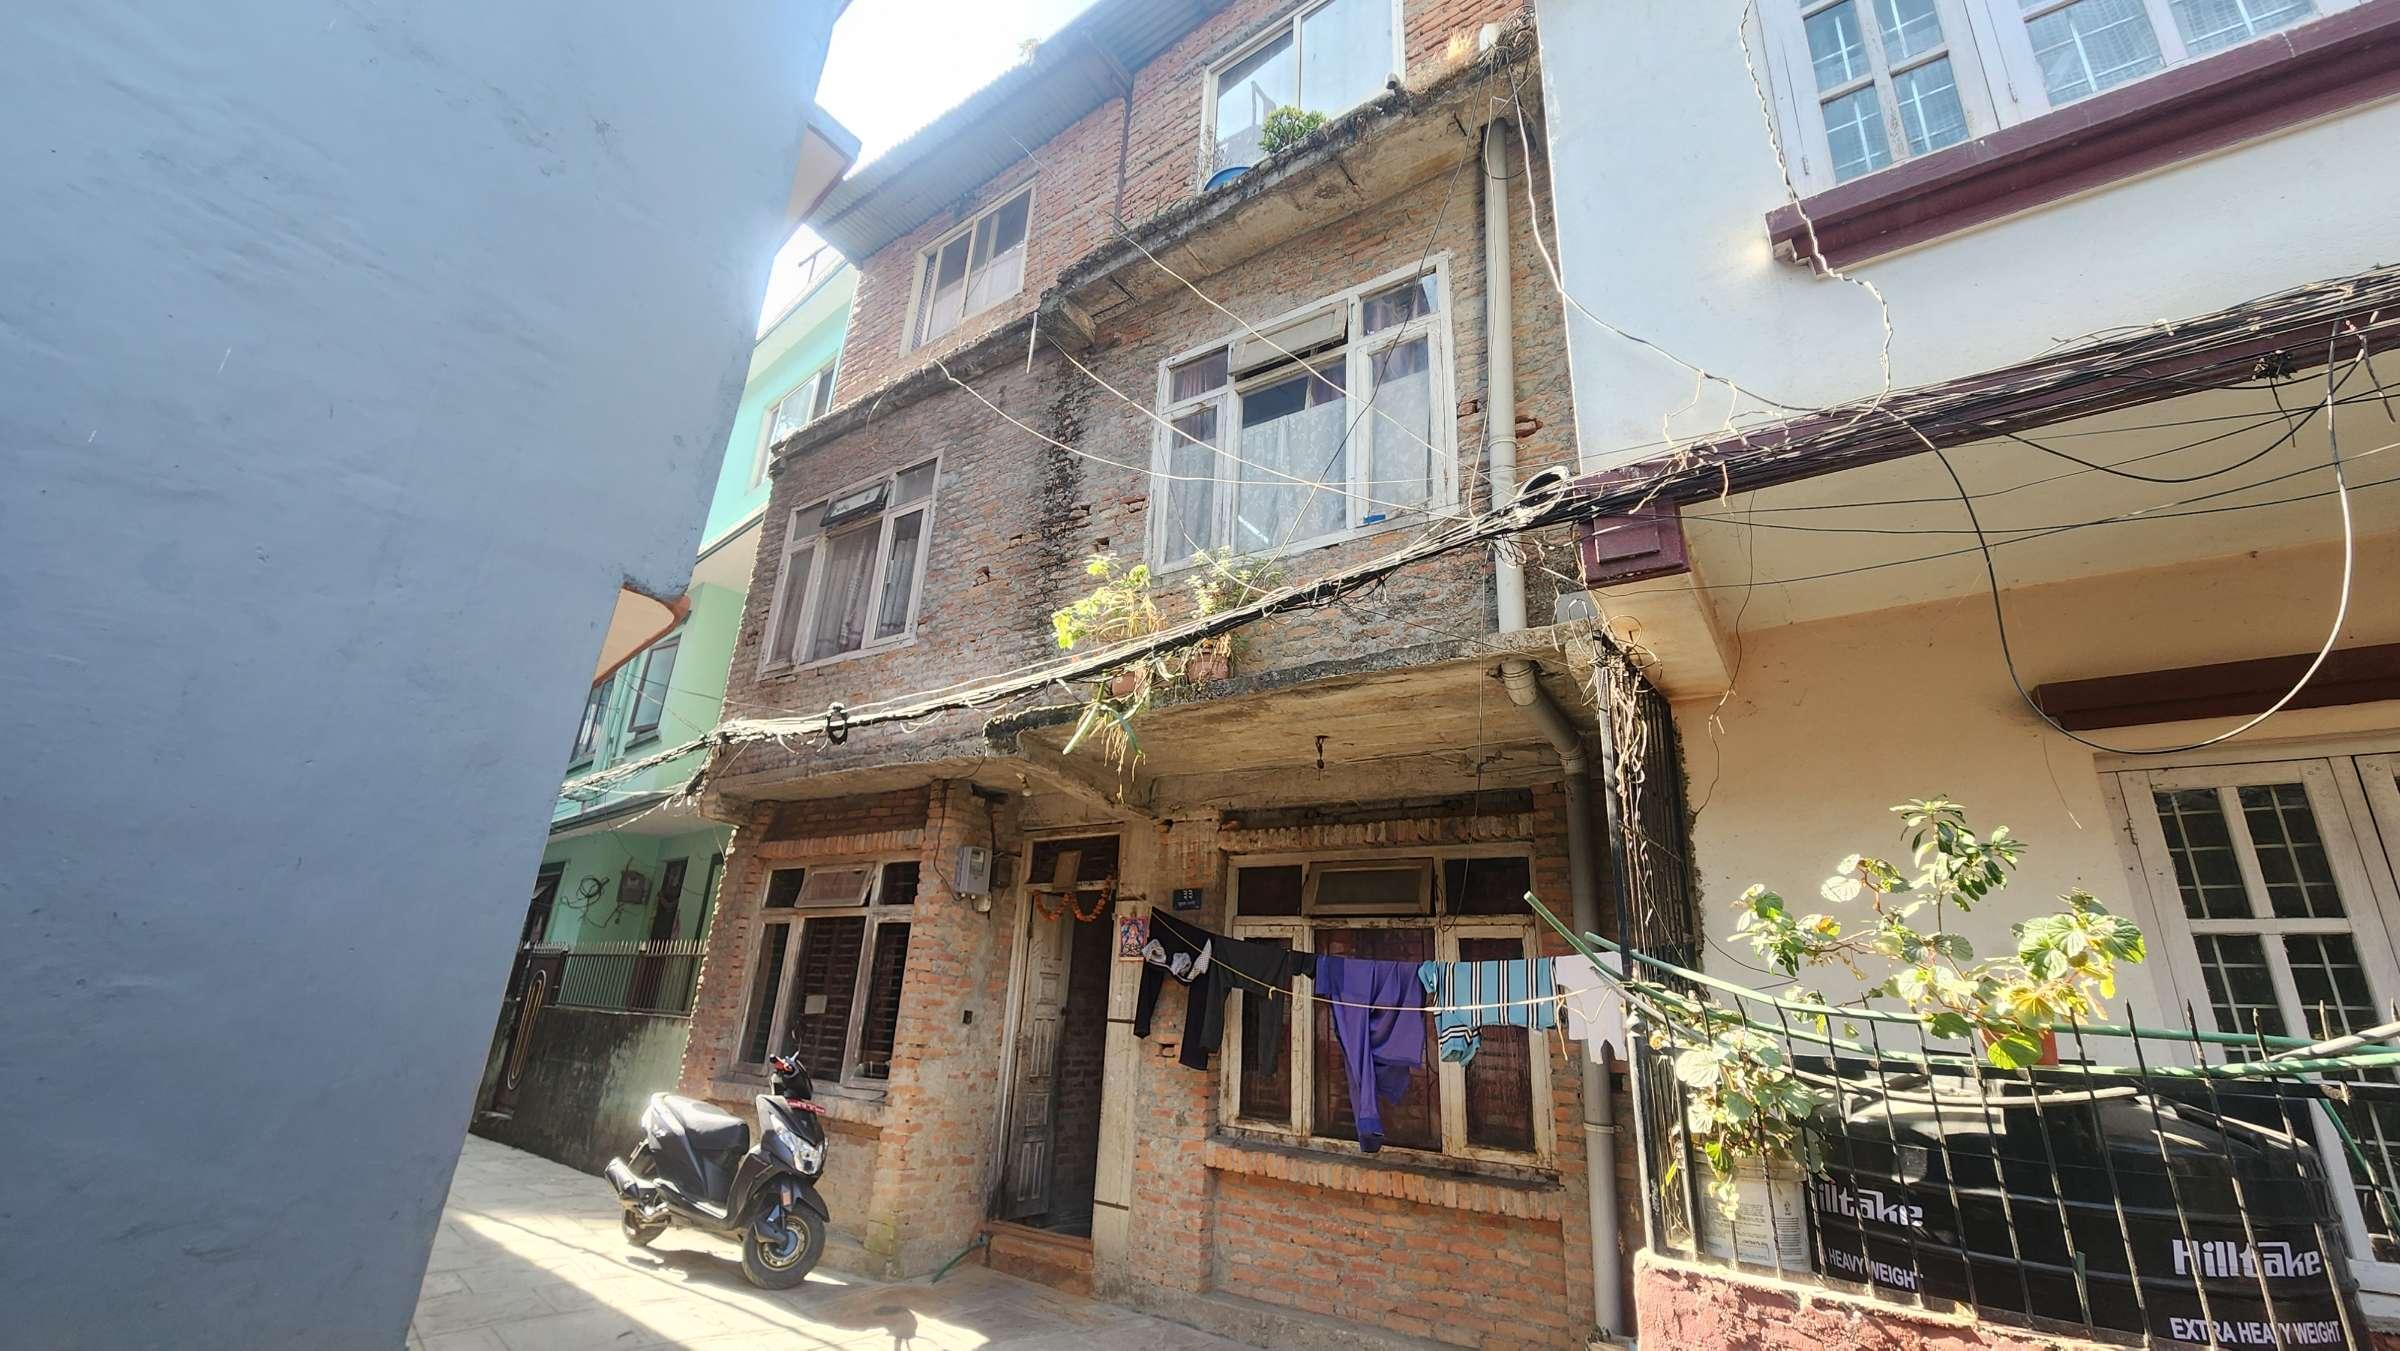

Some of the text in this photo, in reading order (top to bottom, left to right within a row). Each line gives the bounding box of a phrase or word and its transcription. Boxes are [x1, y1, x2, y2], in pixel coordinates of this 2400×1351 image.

[1818, 1183, 1923, 1227] illtake
[1828, 1247, 1864, 1275] HEAVY
[1869, 1260, 1924, 1290] WEIGH
[2172, 1239, 2321, 1277] Hilltake
[2237, 1320, 2292, 1345] HEAY
[2293, 1320, 2341, 1344] WEIGHT
